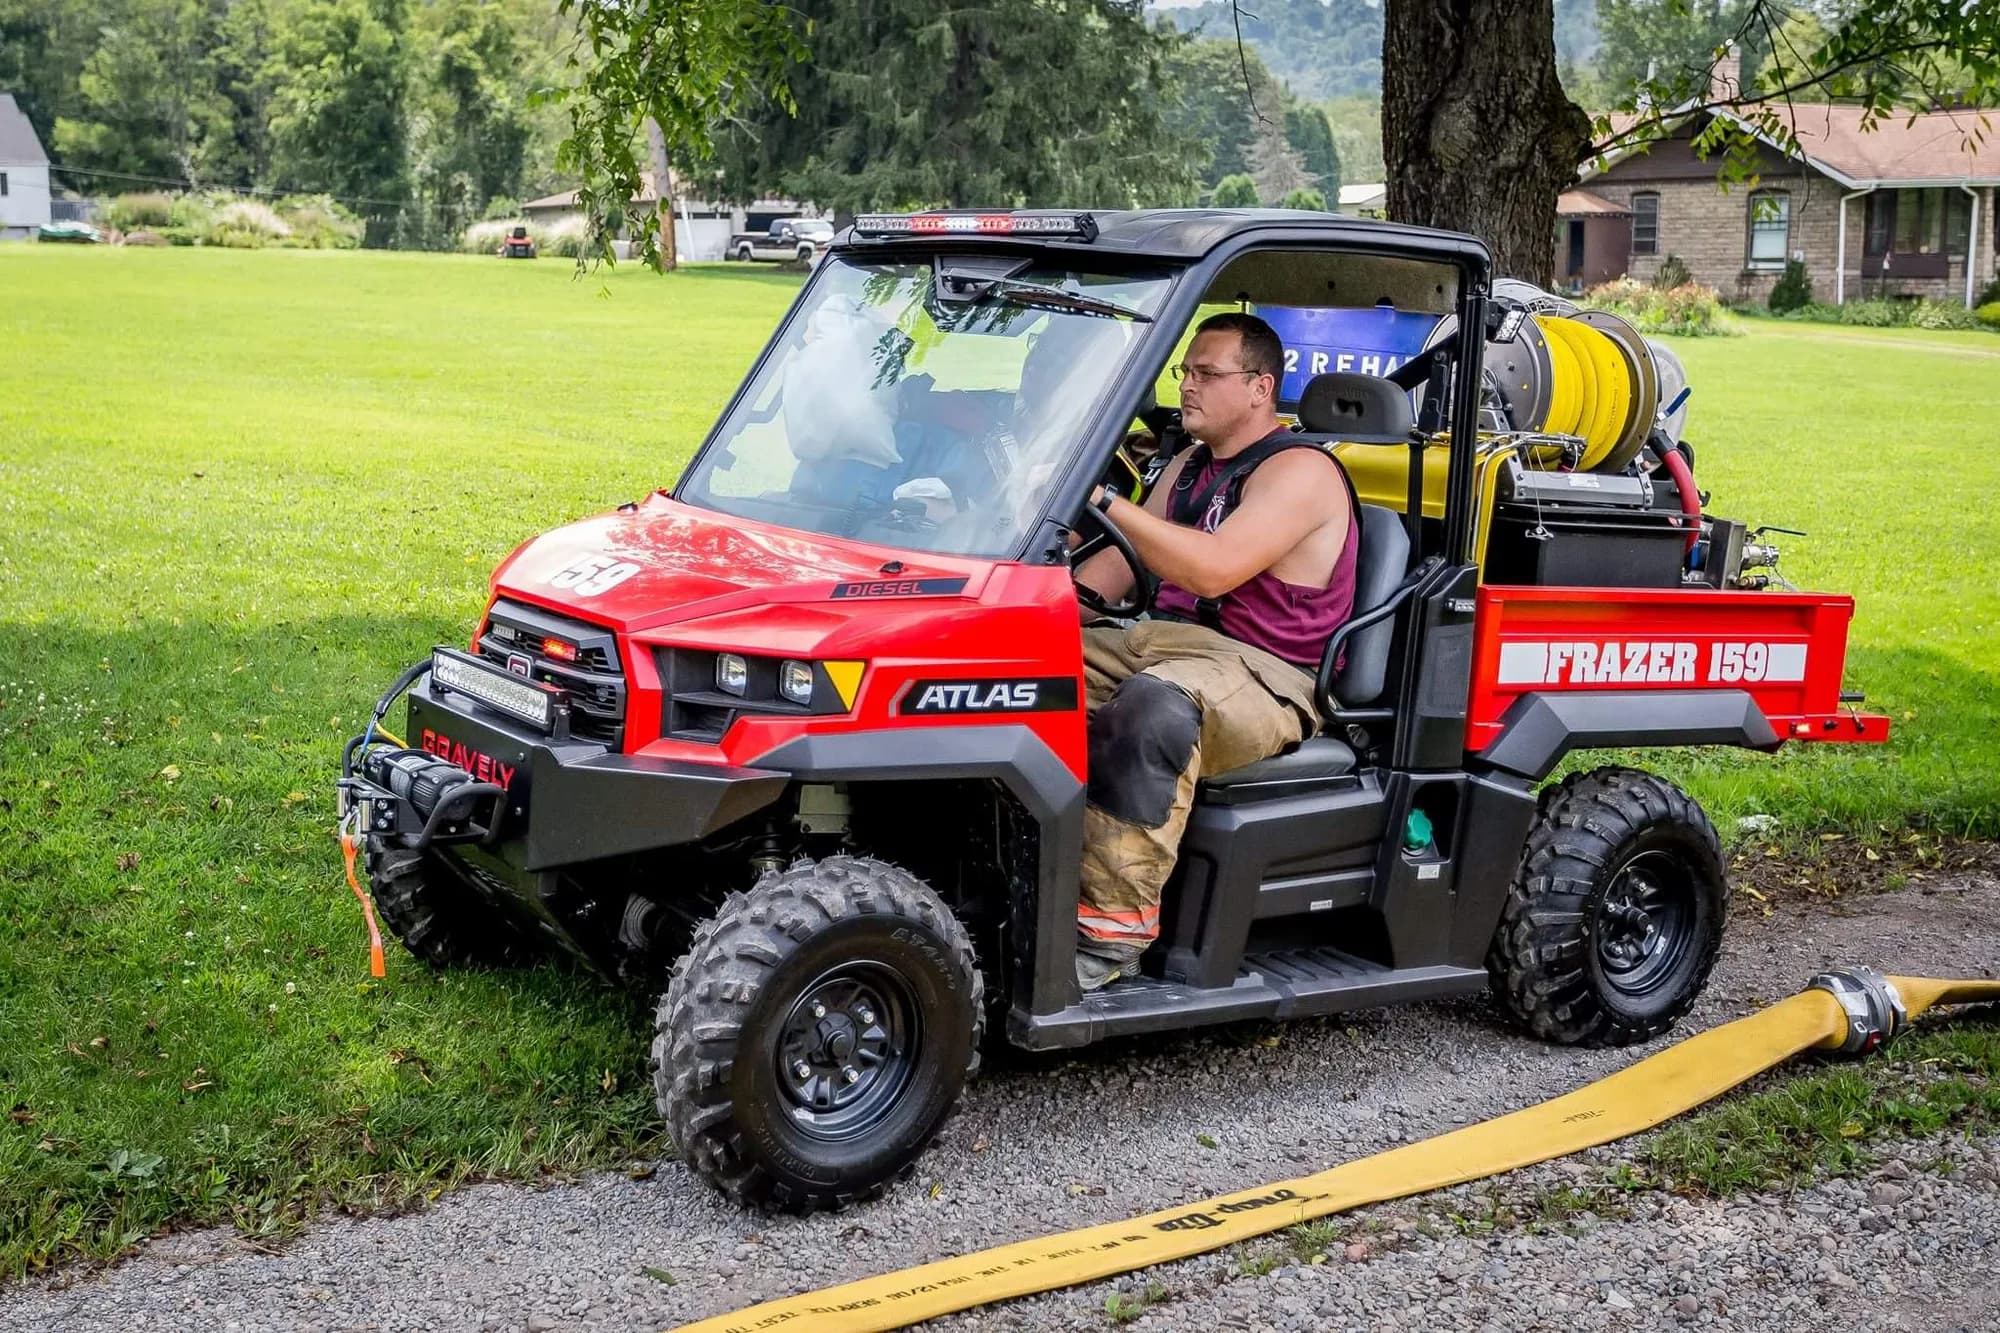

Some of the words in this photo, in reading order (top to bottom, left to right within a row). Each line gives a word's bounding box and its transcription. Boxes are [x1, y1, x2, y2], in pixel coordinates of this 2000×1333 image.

[1311, 351, 1414, 377] REHA
[845, 582, 923, 597] DIESEL
[1545, 641, 1698, 683] FRAZER
[1707, 641, 1768, 682] 159
[915, 683, 1038, 709] ATLAS
[421, 728, 515, 791] GRAVELY
